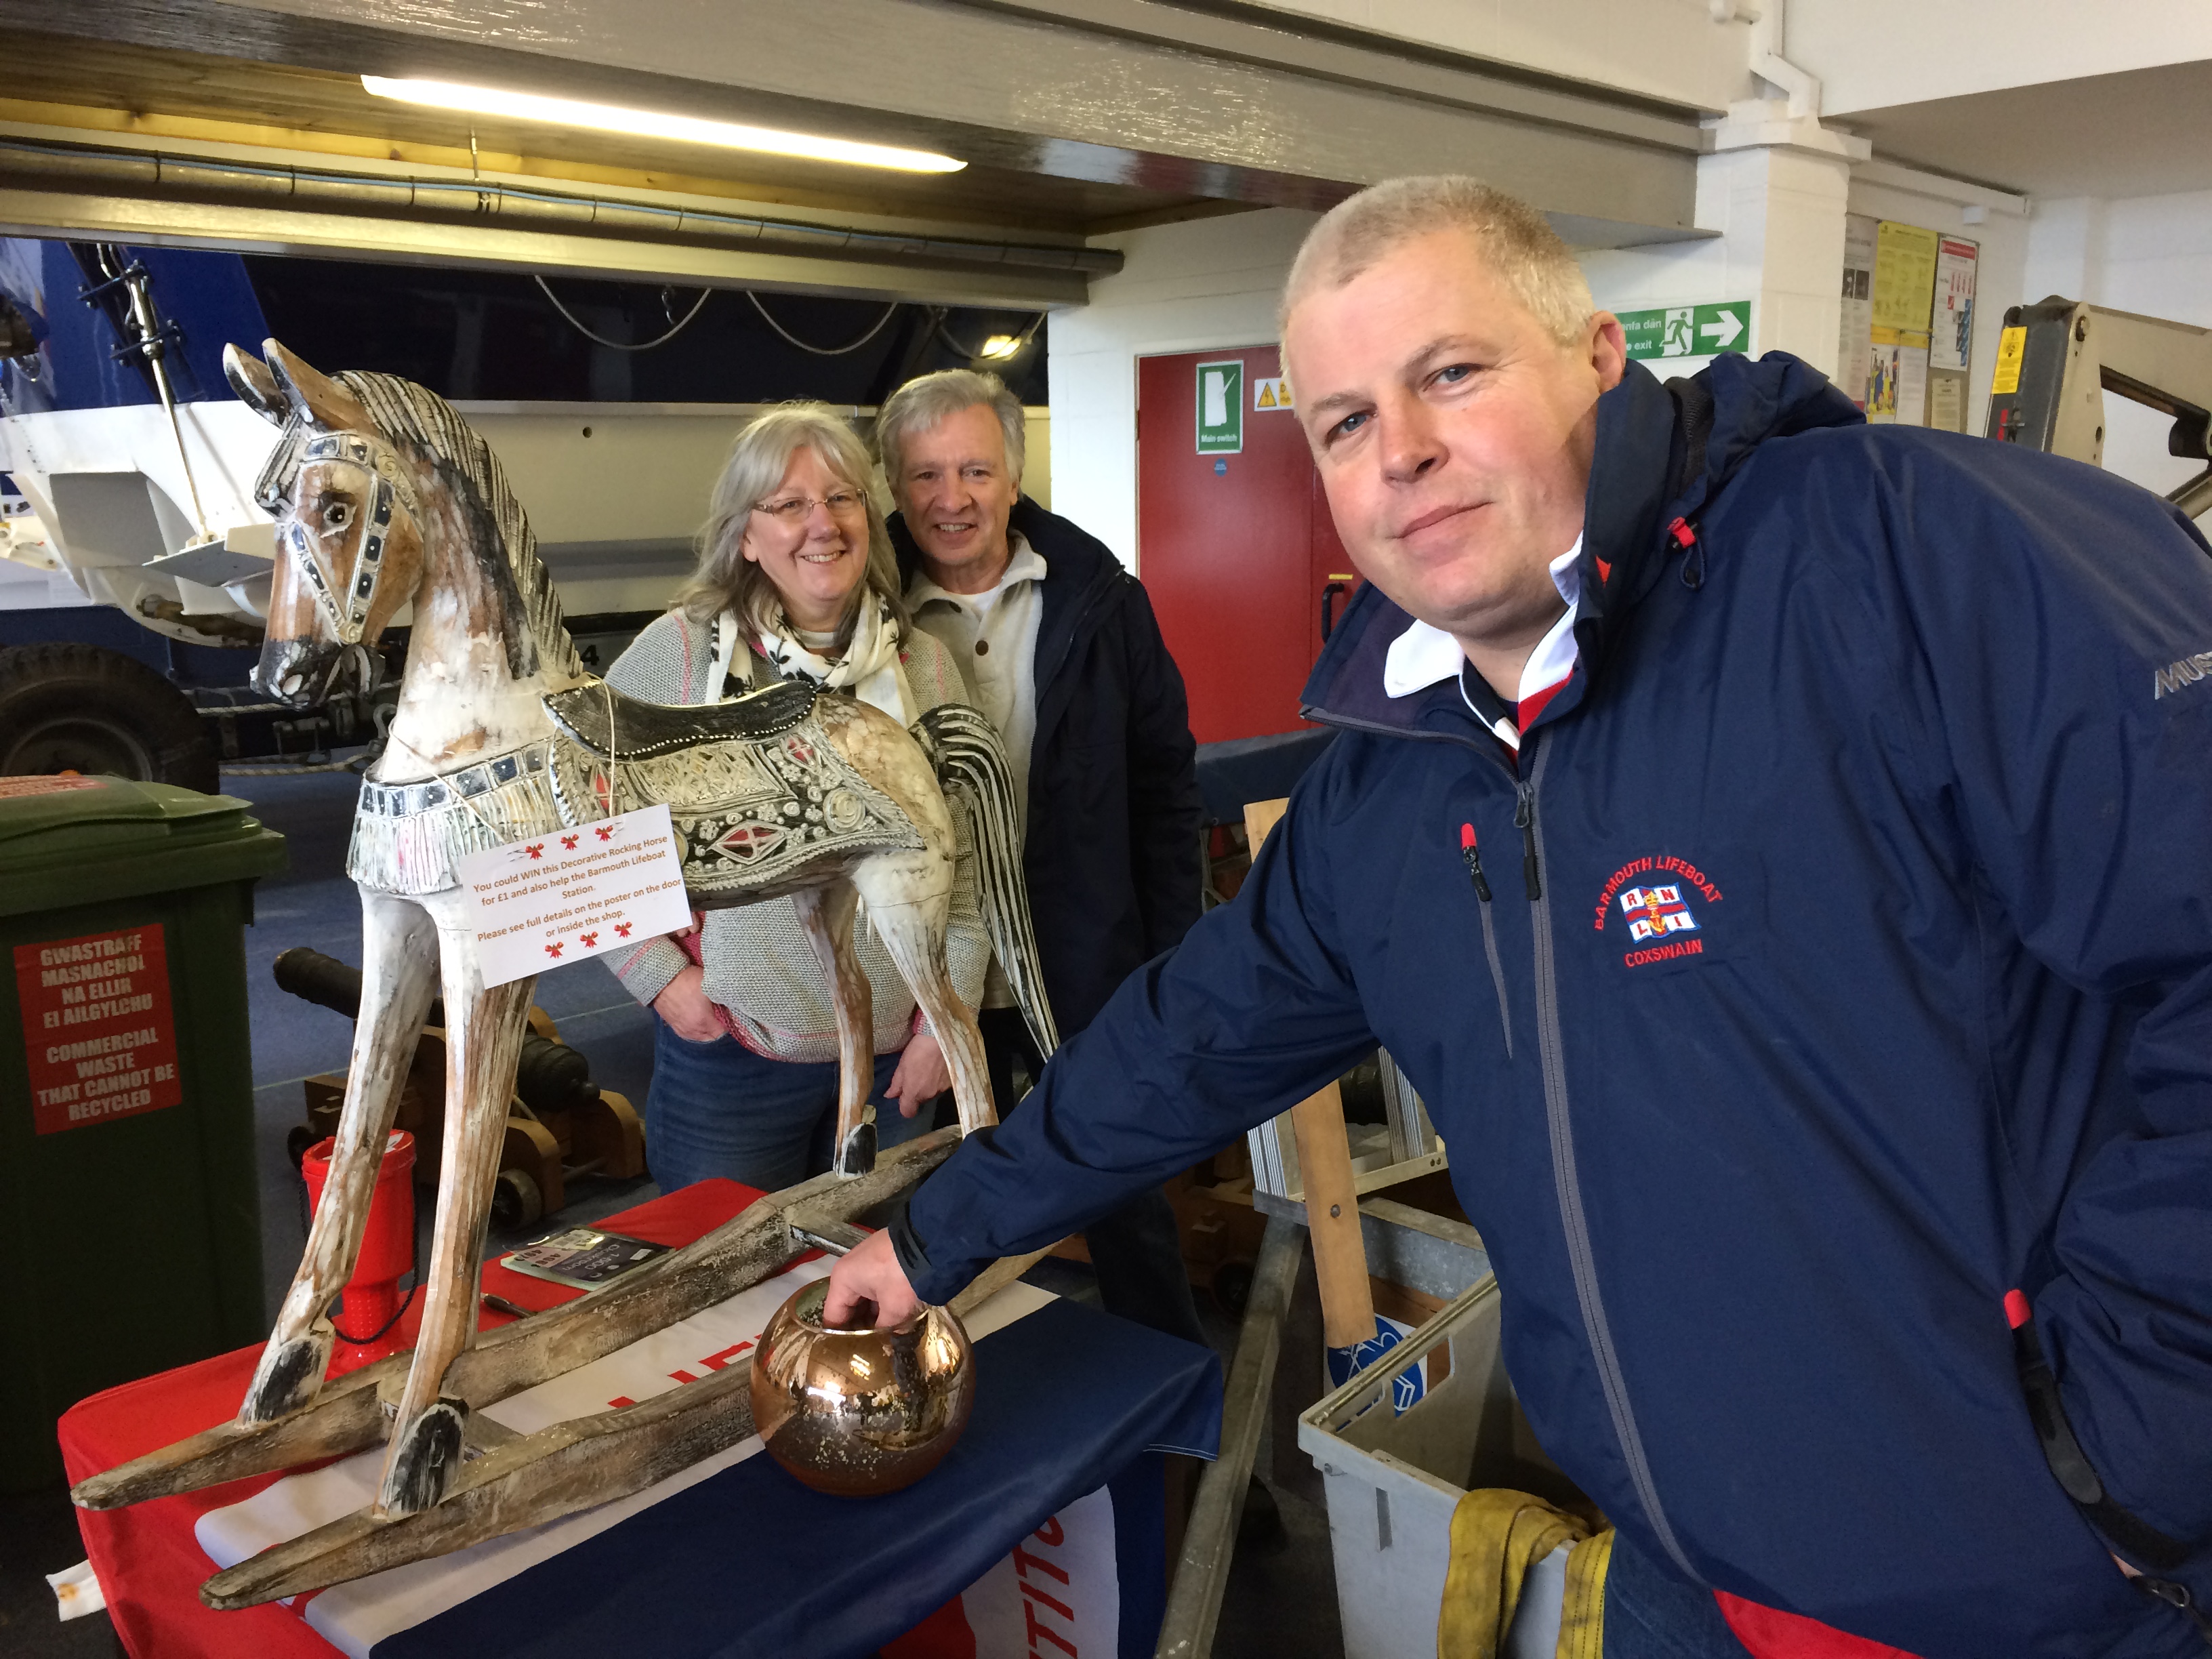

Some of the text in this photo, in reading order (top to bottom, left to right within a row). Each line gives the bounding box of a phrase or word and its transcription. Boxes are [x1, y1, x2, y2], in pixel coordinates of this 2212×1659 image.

[1635, 340, 1652, 350] exit
[474, 836, 668, 893] You could WIN this Decorative Rocking Horse
[482, 851, 665, 906] for £1 and also help the Barmouth Lifeboat
[562, 885, 596, 899] Station.
[1594, 855, 1723, 930] BARMOUTH LIFEBOAT
[1626, 889, 1675, 905] R N
[478, 879, 680, 941] Please see full details on the poster on the door
[558, 921, 583, 934] inside
[586, 917, 599, 926] the
[602, 910, 625, 921] shop.
[1637, 916, 1682, 935] L I
[40, 934, 142, 966] GWASTRAFF
[1624, 939, 1703, 968] COXSWAIN
[41, 954, 146, 987] MASNACHOL
[43, 994, 152, 1028] EI AILGYLCHU
[62, 986, 86, 1004] NA
[46, 1027, 159, 1063] COMMERCIAL
[76, 1052, 136, 1078] WASTE
[37, 1063, 175, 1107] THAT CANNOT BE
[68, 1089, 150, 1121] RECYCLED
